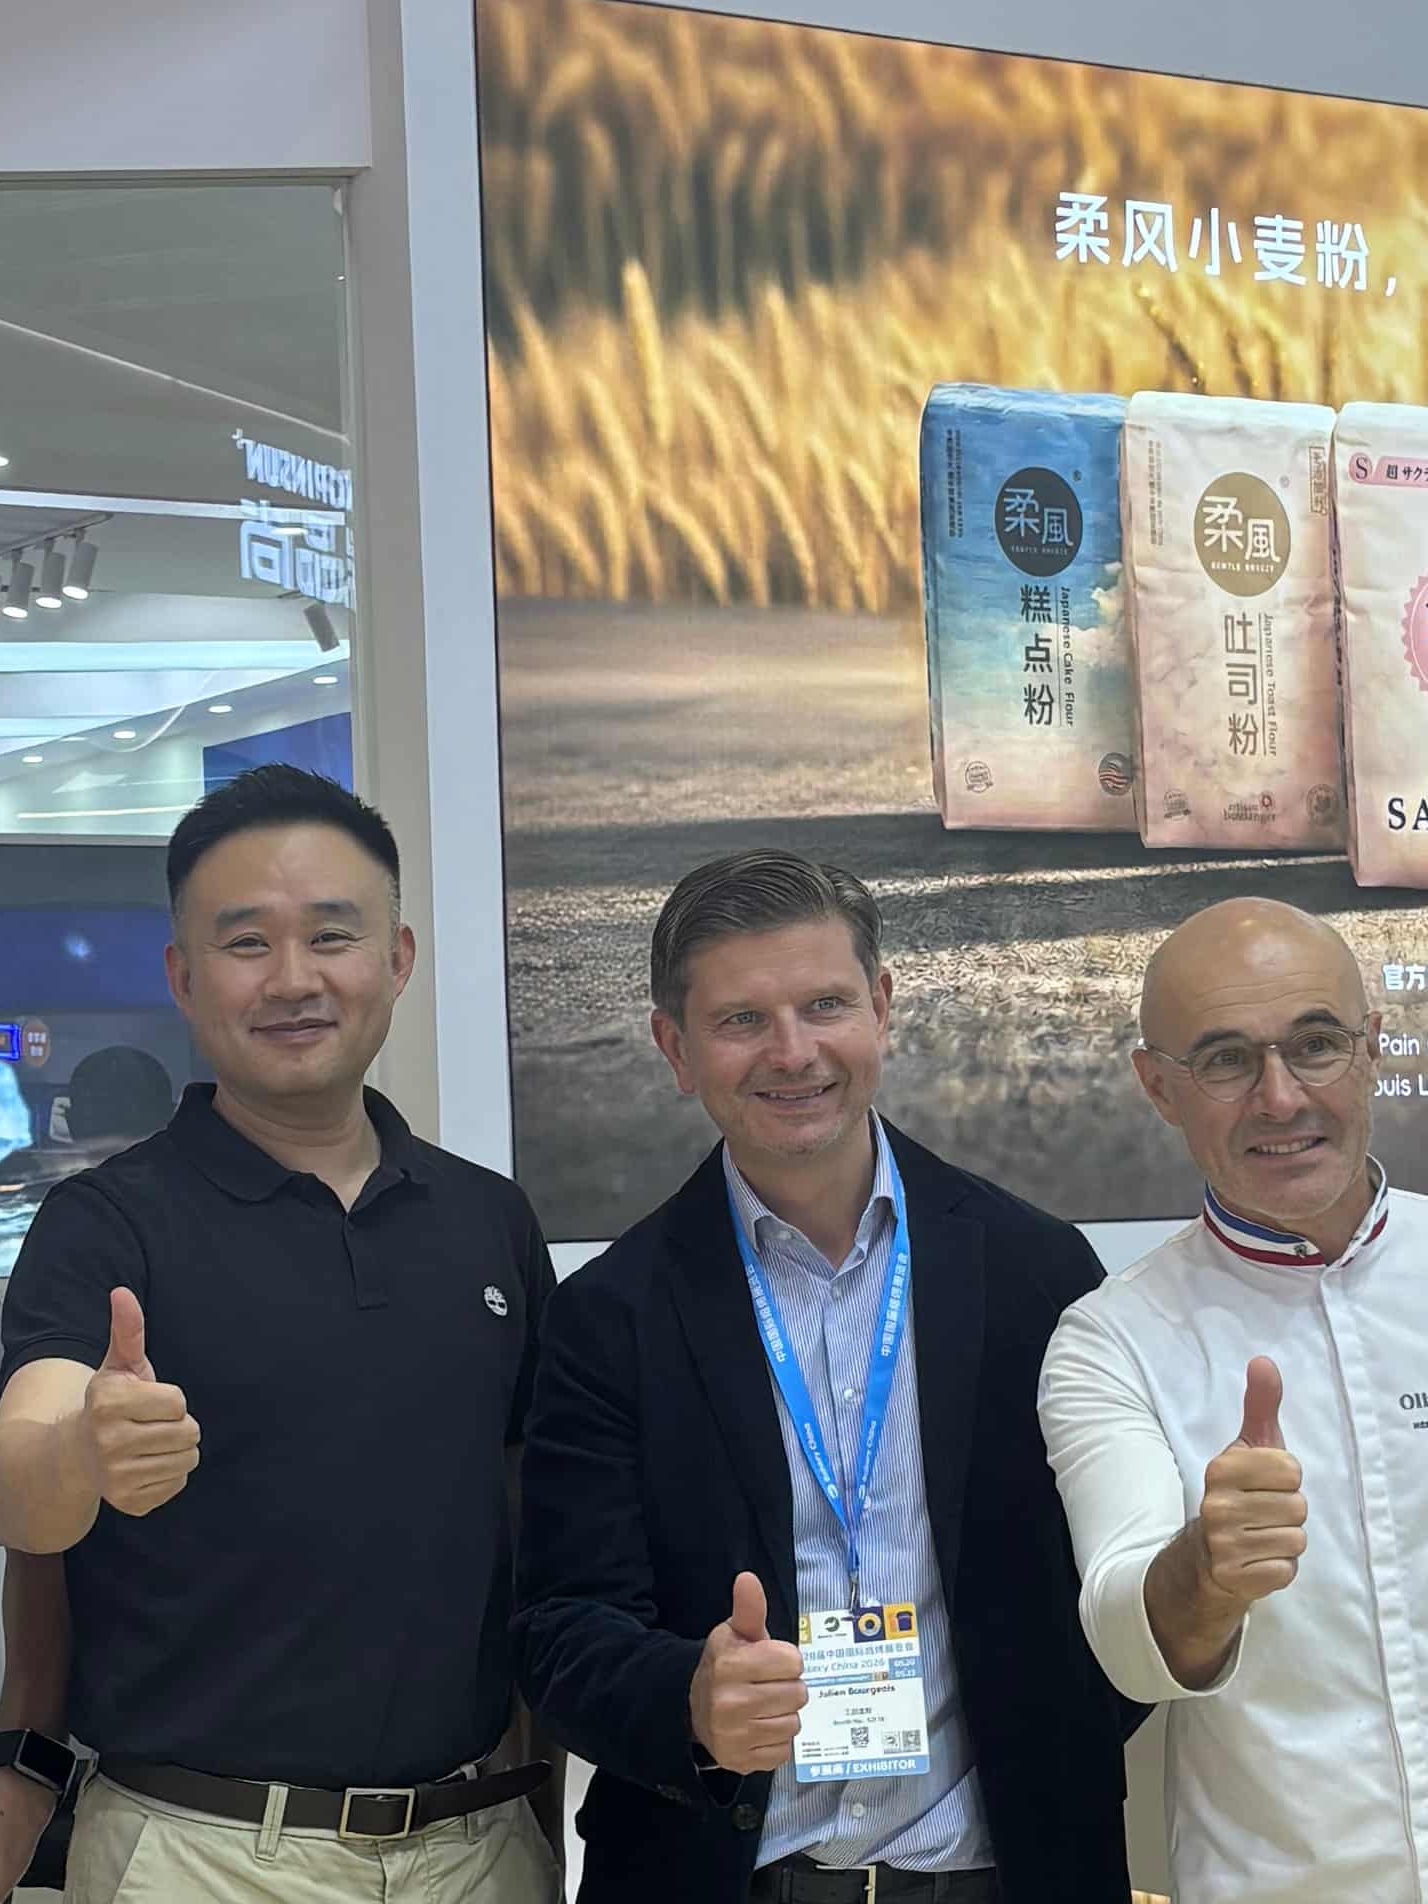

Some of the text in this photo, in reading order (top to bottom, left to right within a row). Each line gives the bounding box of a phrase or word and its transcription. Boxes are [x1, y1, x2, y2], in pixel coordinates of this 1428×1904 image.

[1355, 456, 1368, 480] S
[1003, 487, 1074, 547] 柔風
[1202, 495, 1282, 563] 柔風
[1019, 583, 1055, 727] 糕点粉
[1224, 612, 1261, 757] 吐司粉
[1378, 1033, 1420, 1058] Pain
[852, 1759, 917, 1773] EXHIBITOR
